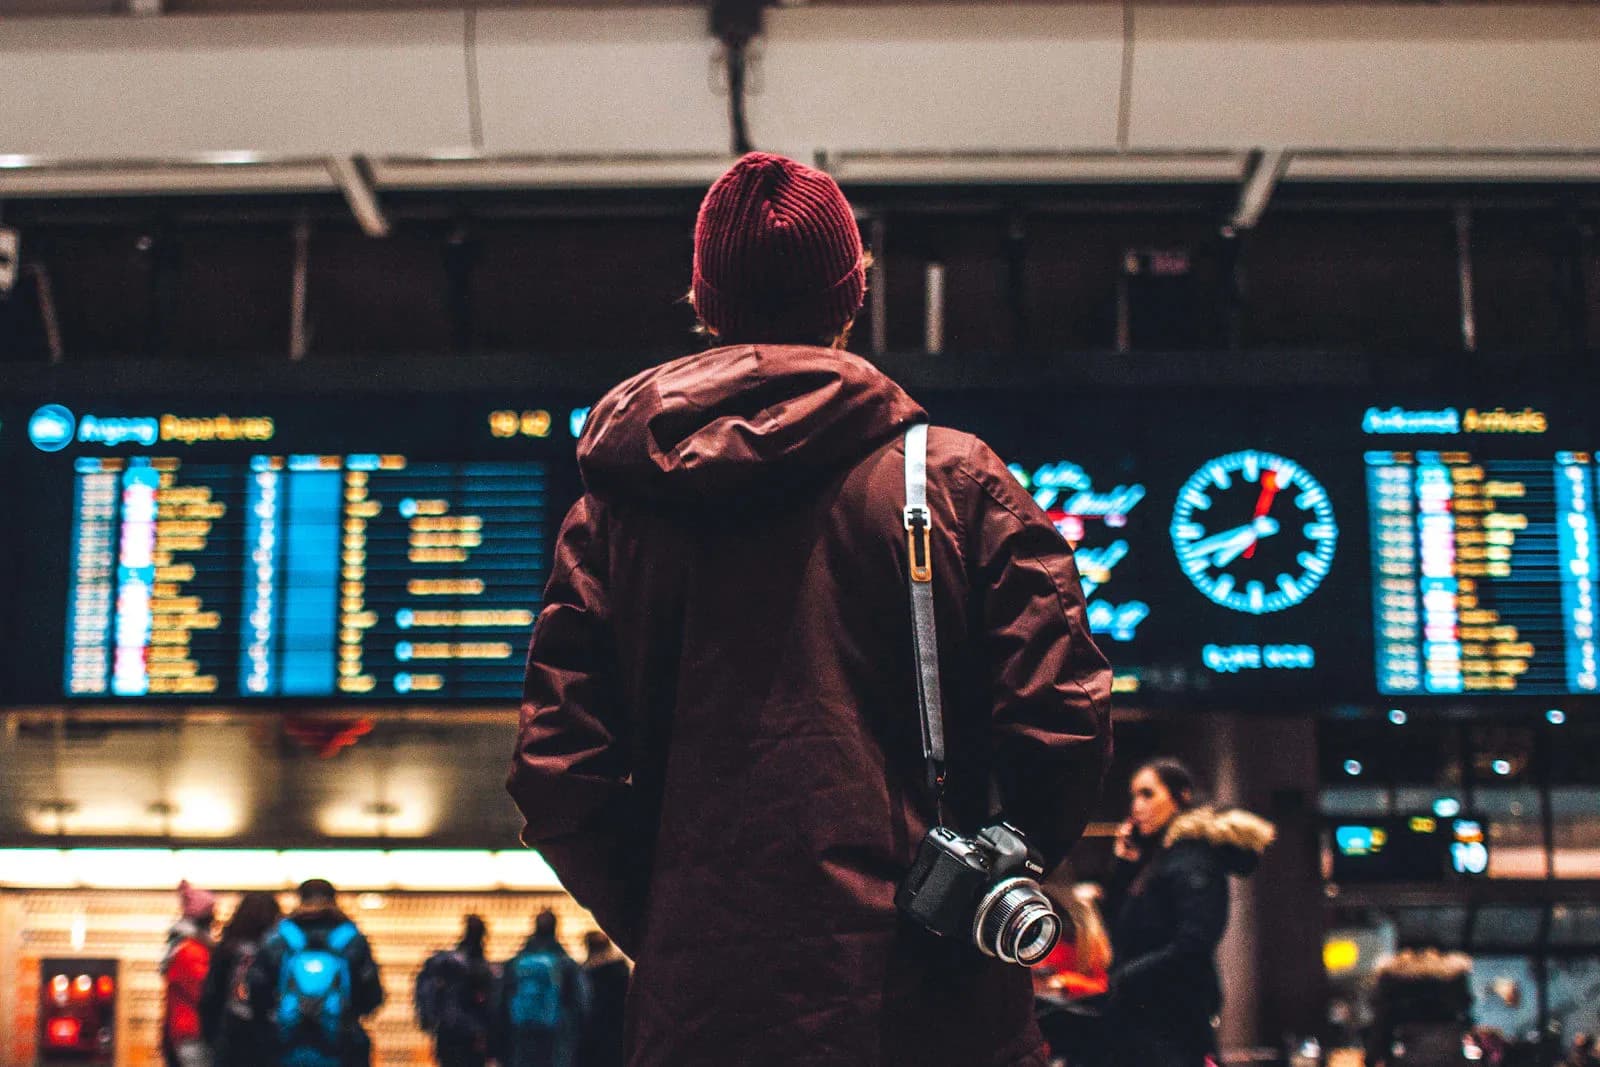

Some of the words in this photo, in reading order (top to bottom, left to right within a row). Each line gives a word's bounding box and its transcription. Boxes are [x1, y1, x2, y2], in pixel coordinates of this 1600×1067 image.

[160, 414, 274, 444] Departures
[1464, 408, 1548, 432] Arrivals
[1025, 859, 1044, 875] Canon
